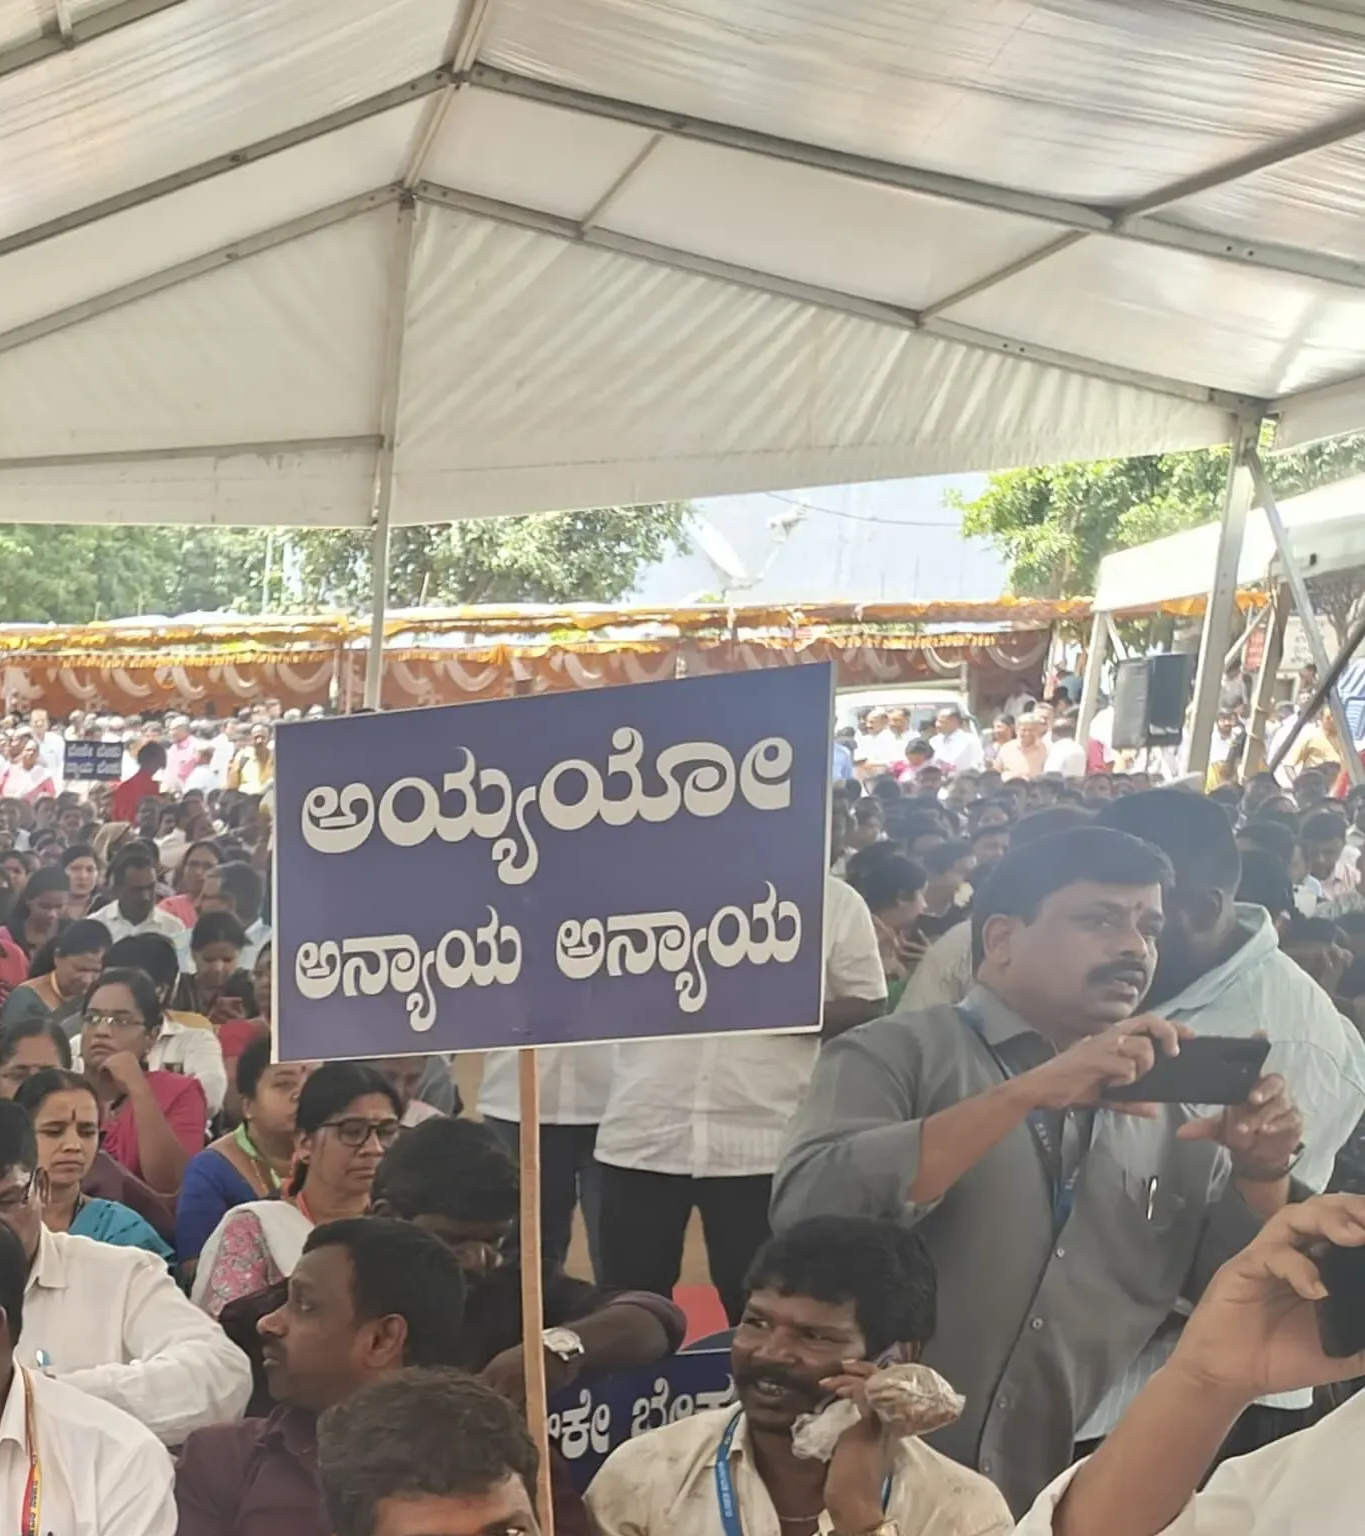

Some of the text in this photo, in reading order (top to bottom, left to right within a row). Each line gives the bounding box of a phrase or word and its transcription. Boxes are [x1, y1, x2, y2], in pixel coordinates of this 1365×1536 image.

[301, 726, 794, 885] ಅಯ್ಯಯೋ
[295, 880, 803, 1033] ಅನ್ಯಾಯ ಅನ್ಯಾಯ
